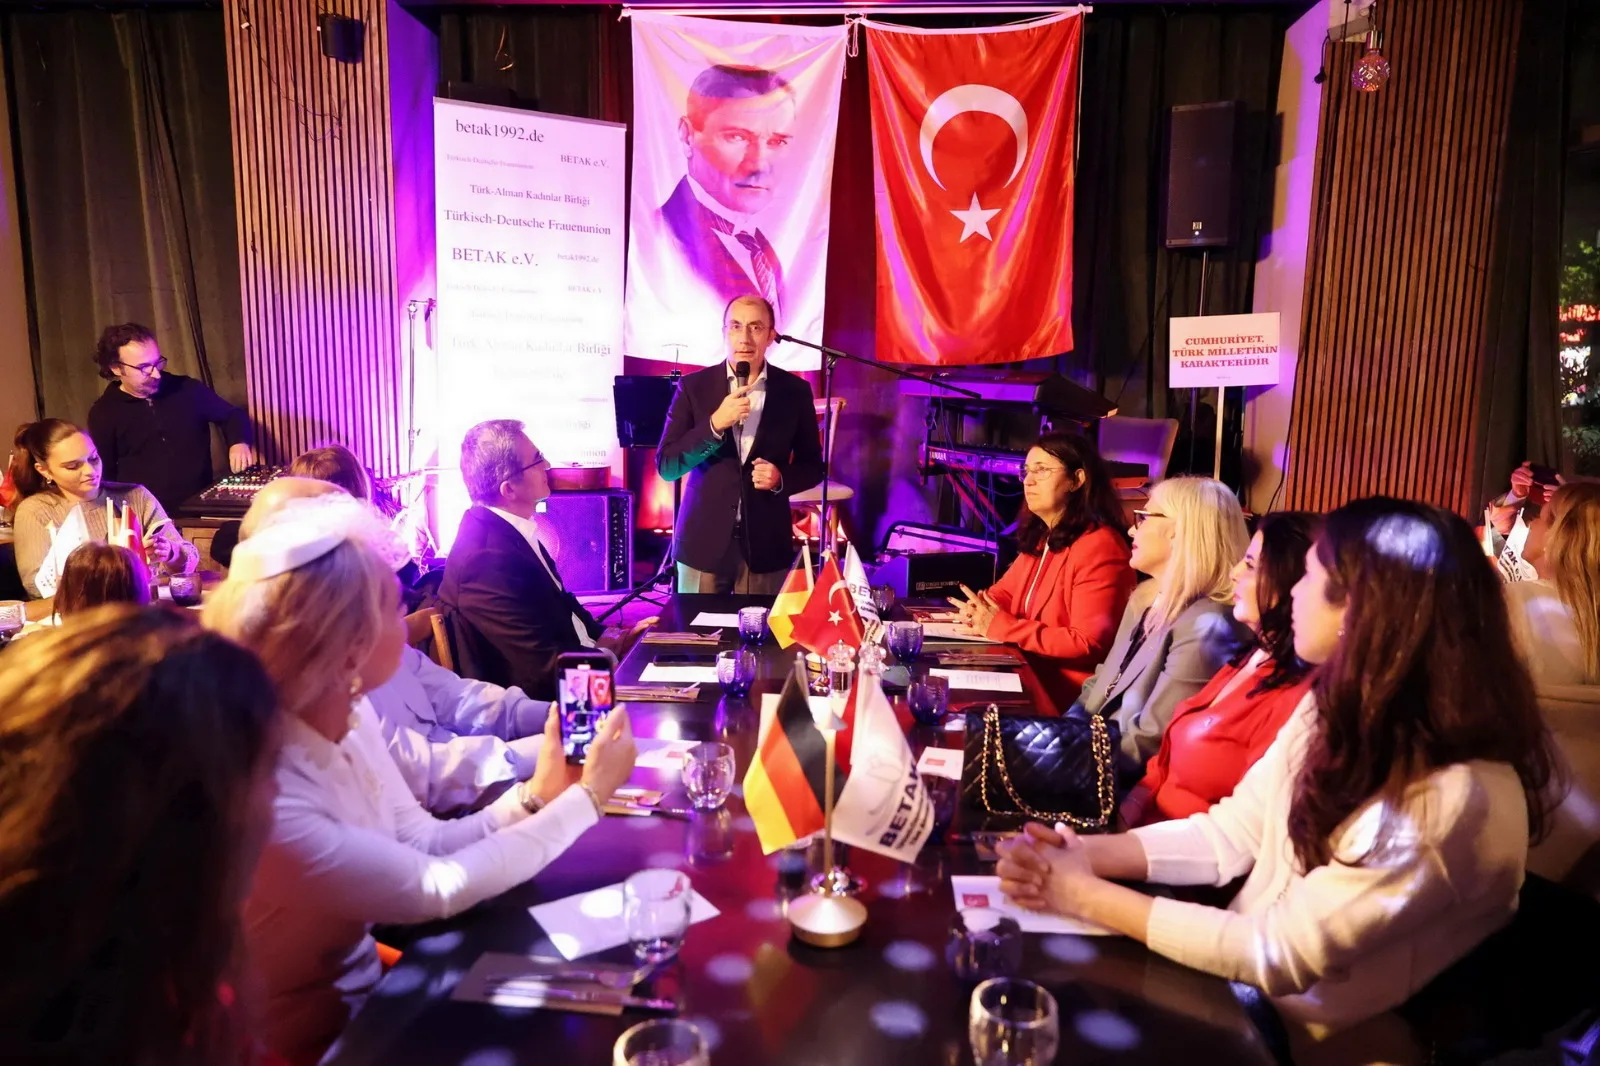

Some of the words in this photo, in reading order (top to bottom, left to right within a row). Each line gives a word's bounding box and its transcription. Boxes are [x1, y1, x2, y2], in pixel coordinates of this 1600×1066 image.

[455, 119, 545, 143] betak1992.de
[560, 154, 591, 167] BETAK
[593, 159, 610, 169] e.V.
[470, 184, 524, 198] Türk-Alman
[526, 190, 562, 202] Kadınlar
[564, 194, 591, 207] Birliği
[444, 209, 545, 229] Türkisch-Deutsche
[548, 219, 611, 235] Frauenunion
[452, 247, 507, 264] BETAK
[511, 253, 539, 266] e.V.
[1185, 334, 1265, 346] CUMHURİYET,
[577, 342, 611, 357] Birliği
[1172, 347, 1204, 357] TÜRK
[1207, 345, 1278, 356] MİLLETİNİN
[1180, 356, 1269, 368] KARAKTERİDİR
